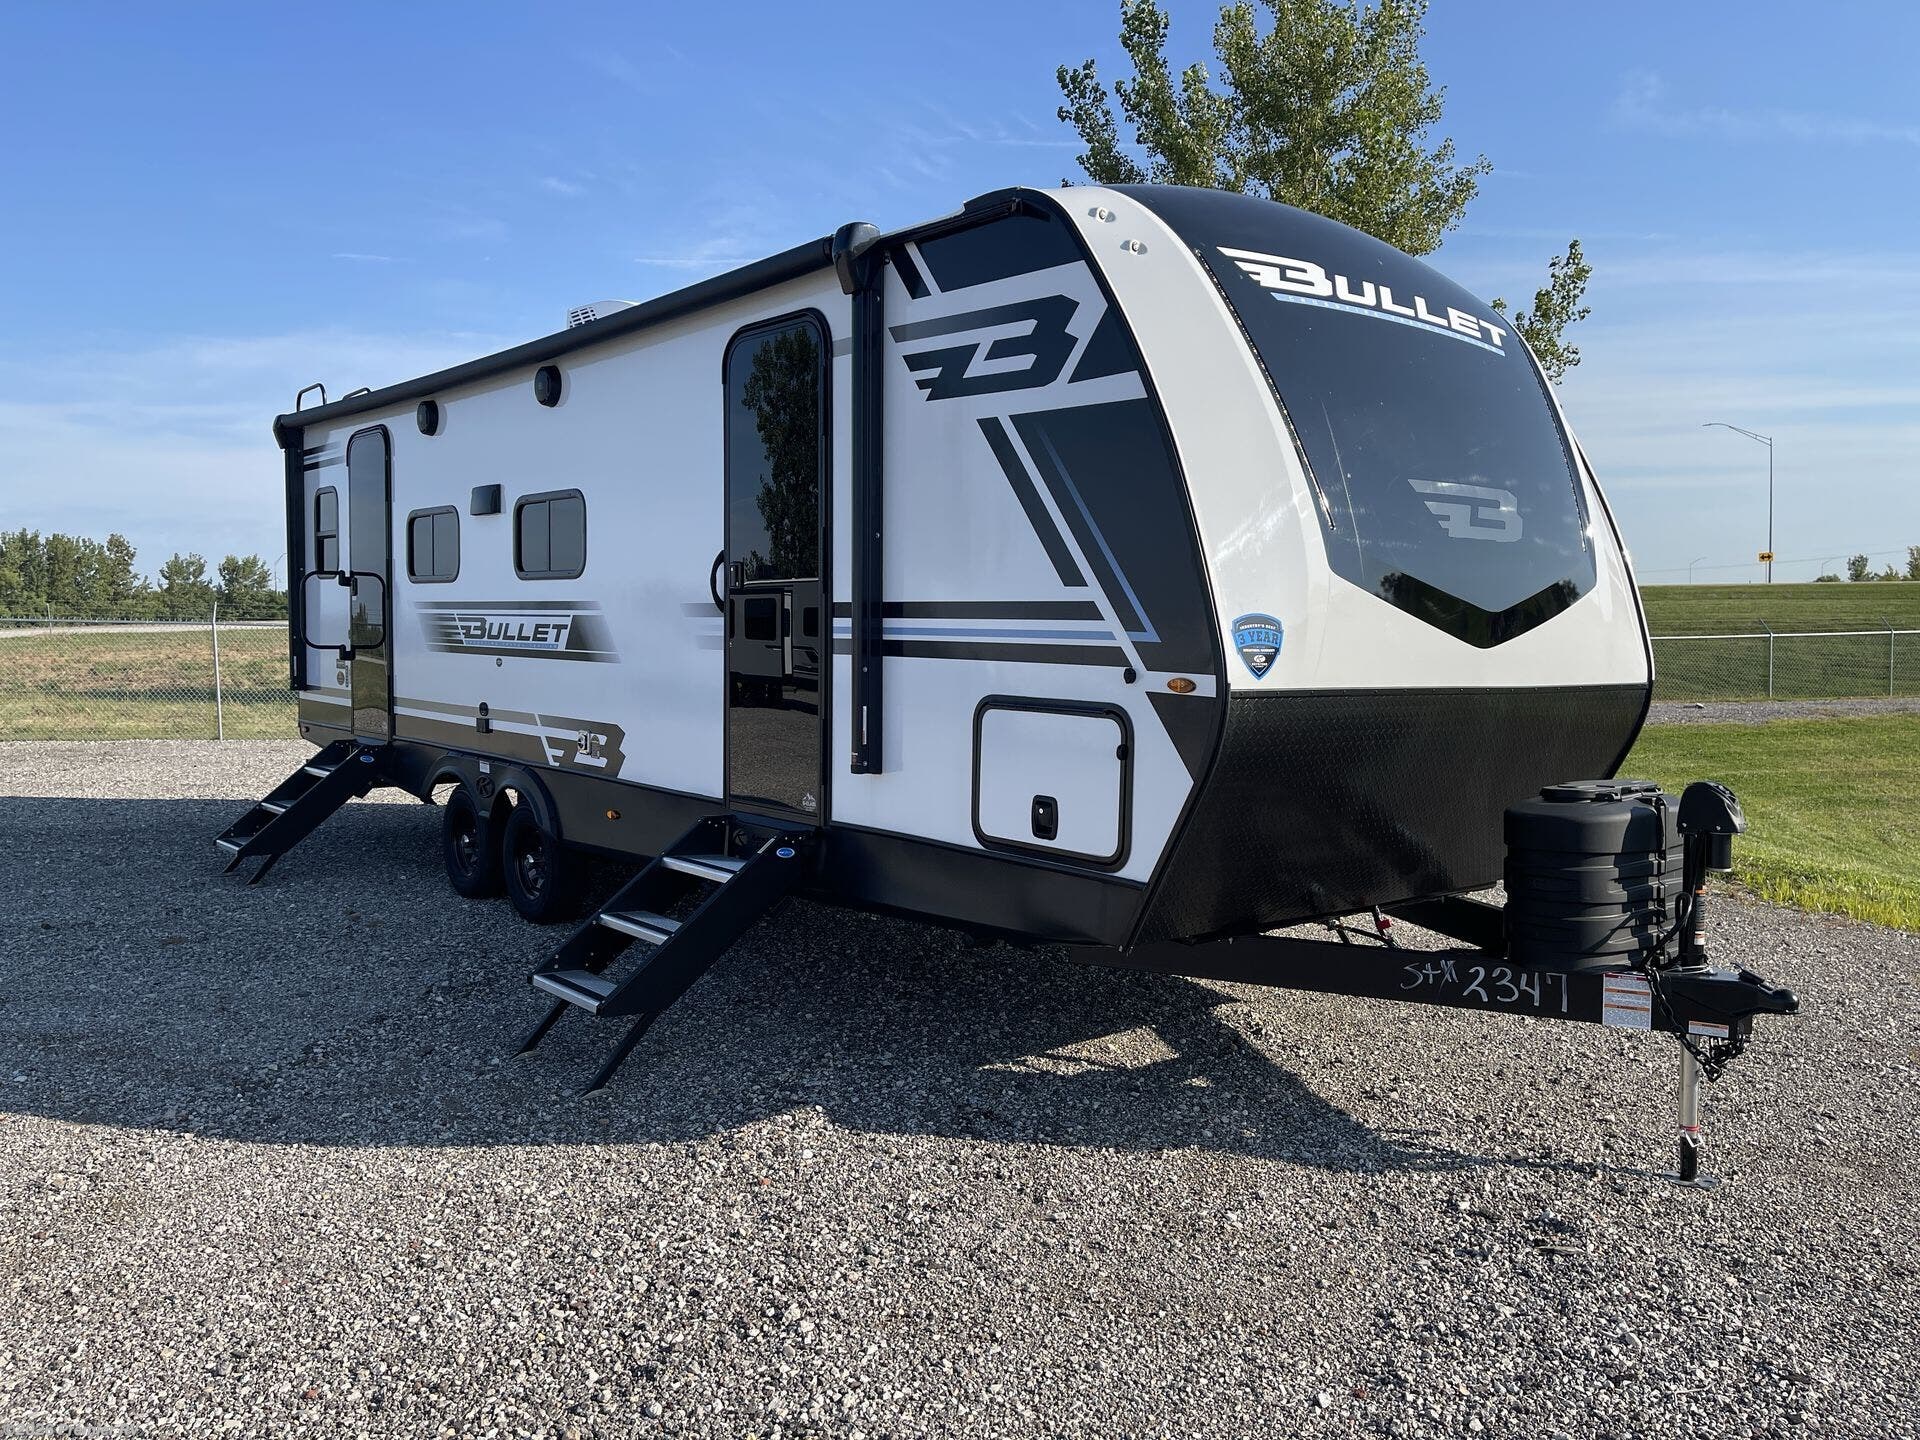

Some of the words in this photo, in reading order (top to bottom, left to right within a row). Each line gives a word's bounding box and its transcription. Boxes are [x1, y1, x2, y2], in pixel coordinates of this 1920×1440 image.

[1239, 634, 1246, 644] 3
[1248, 631, 1279, 645] YEAR
[1462, 966, 1569, 1014] 2347
